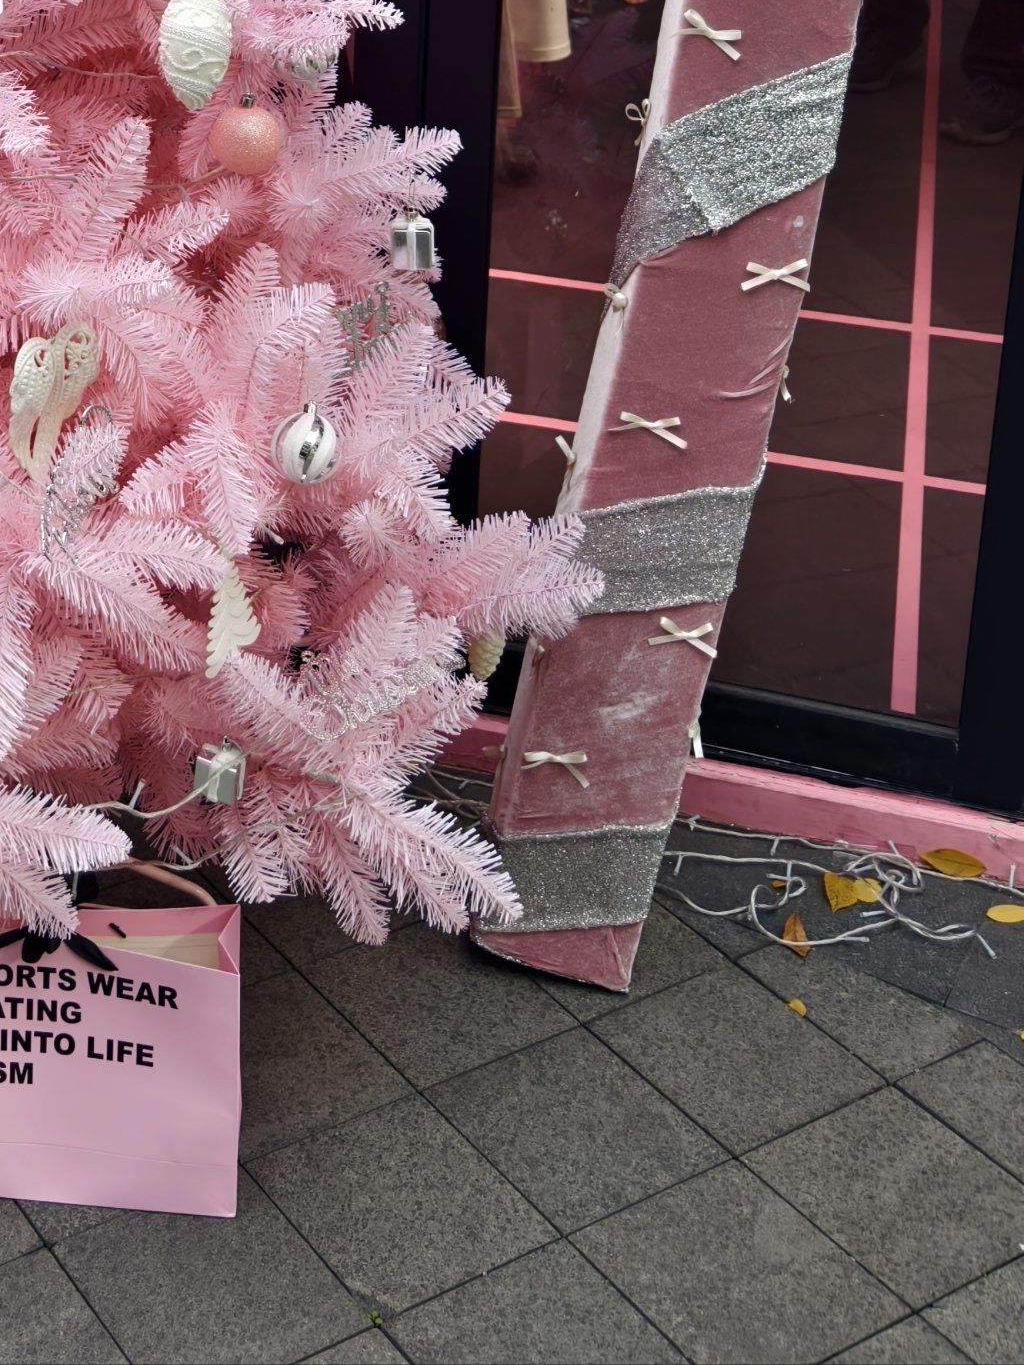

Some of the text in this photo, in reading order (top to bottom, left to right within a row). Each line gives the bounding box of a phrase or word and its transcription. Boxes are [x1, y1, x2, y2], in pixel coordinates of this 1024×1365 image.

[86, 970, 179, 1010] WEAR
[0, 1028, 76, 1056] INTO
[86, 1035, 155, 1068] LIFE
